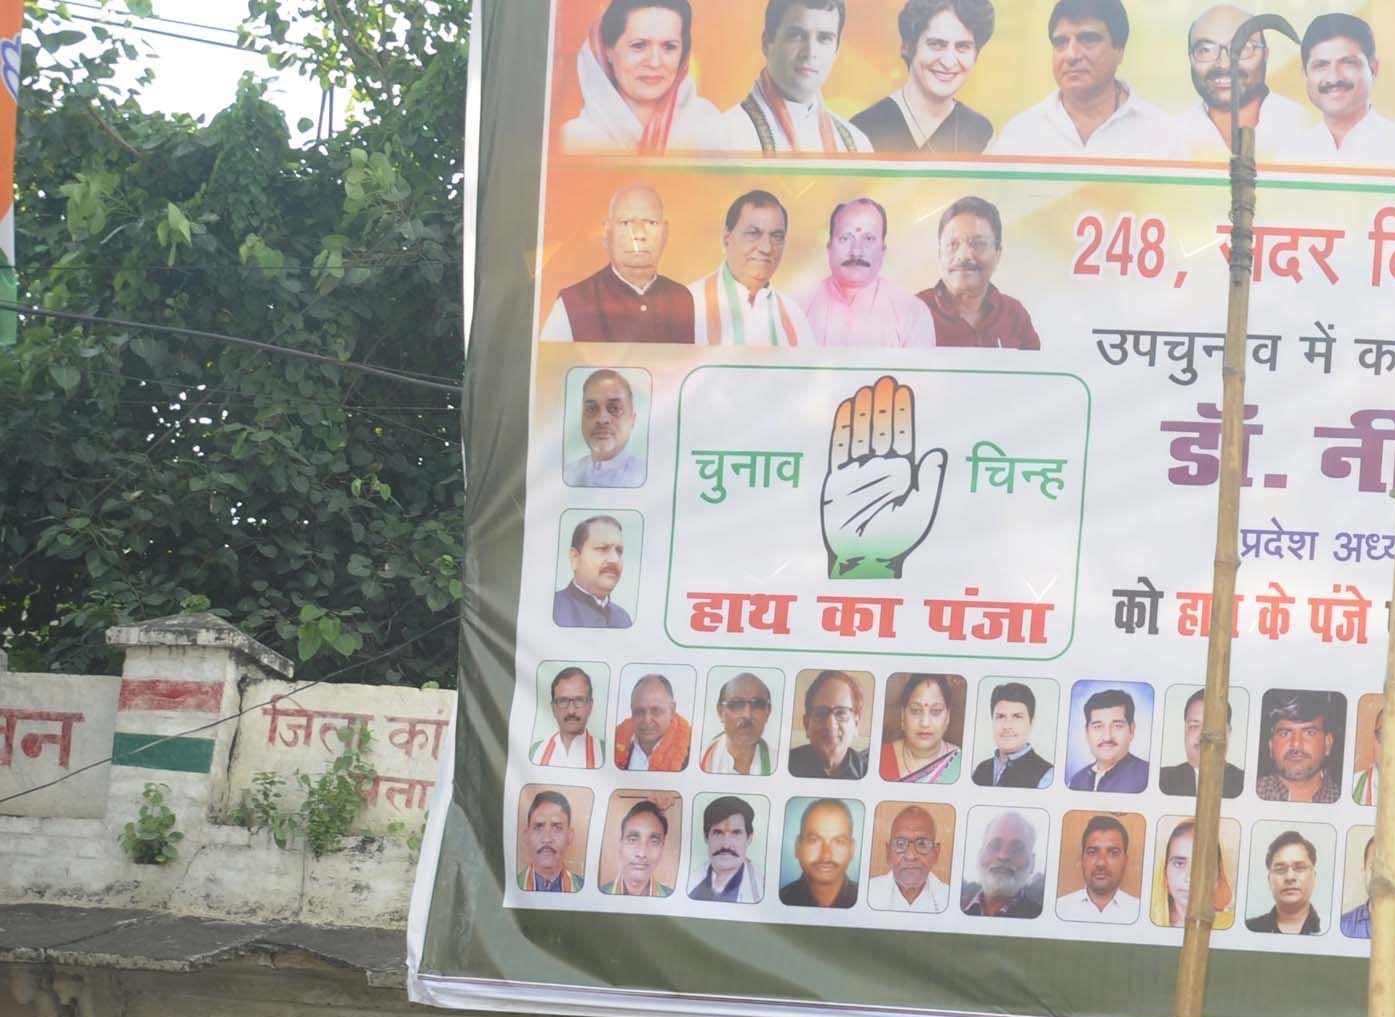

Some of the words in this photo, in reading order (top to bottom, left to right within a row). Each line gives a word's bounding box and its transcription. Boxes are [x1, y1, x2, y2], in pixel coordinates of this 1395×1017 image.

[1073, 216, 1188, 288] 248,
[1300, 321, 1337, 374] में
[691, 450, 804, 504] चुनाव
[966, 441, 1067, 500] चिन्ह
[1240, 517, 1319, 560] प्रदेश
[686, 592, 797, 634] हाथ
[816, 596, 904, 639] का
[923, 587, 1055, 644] पंजा
[1112, 576, 1164, 635] को
[1256, 582, 1295, 640] के
[1308, 583, 1372, 644] पंजे
